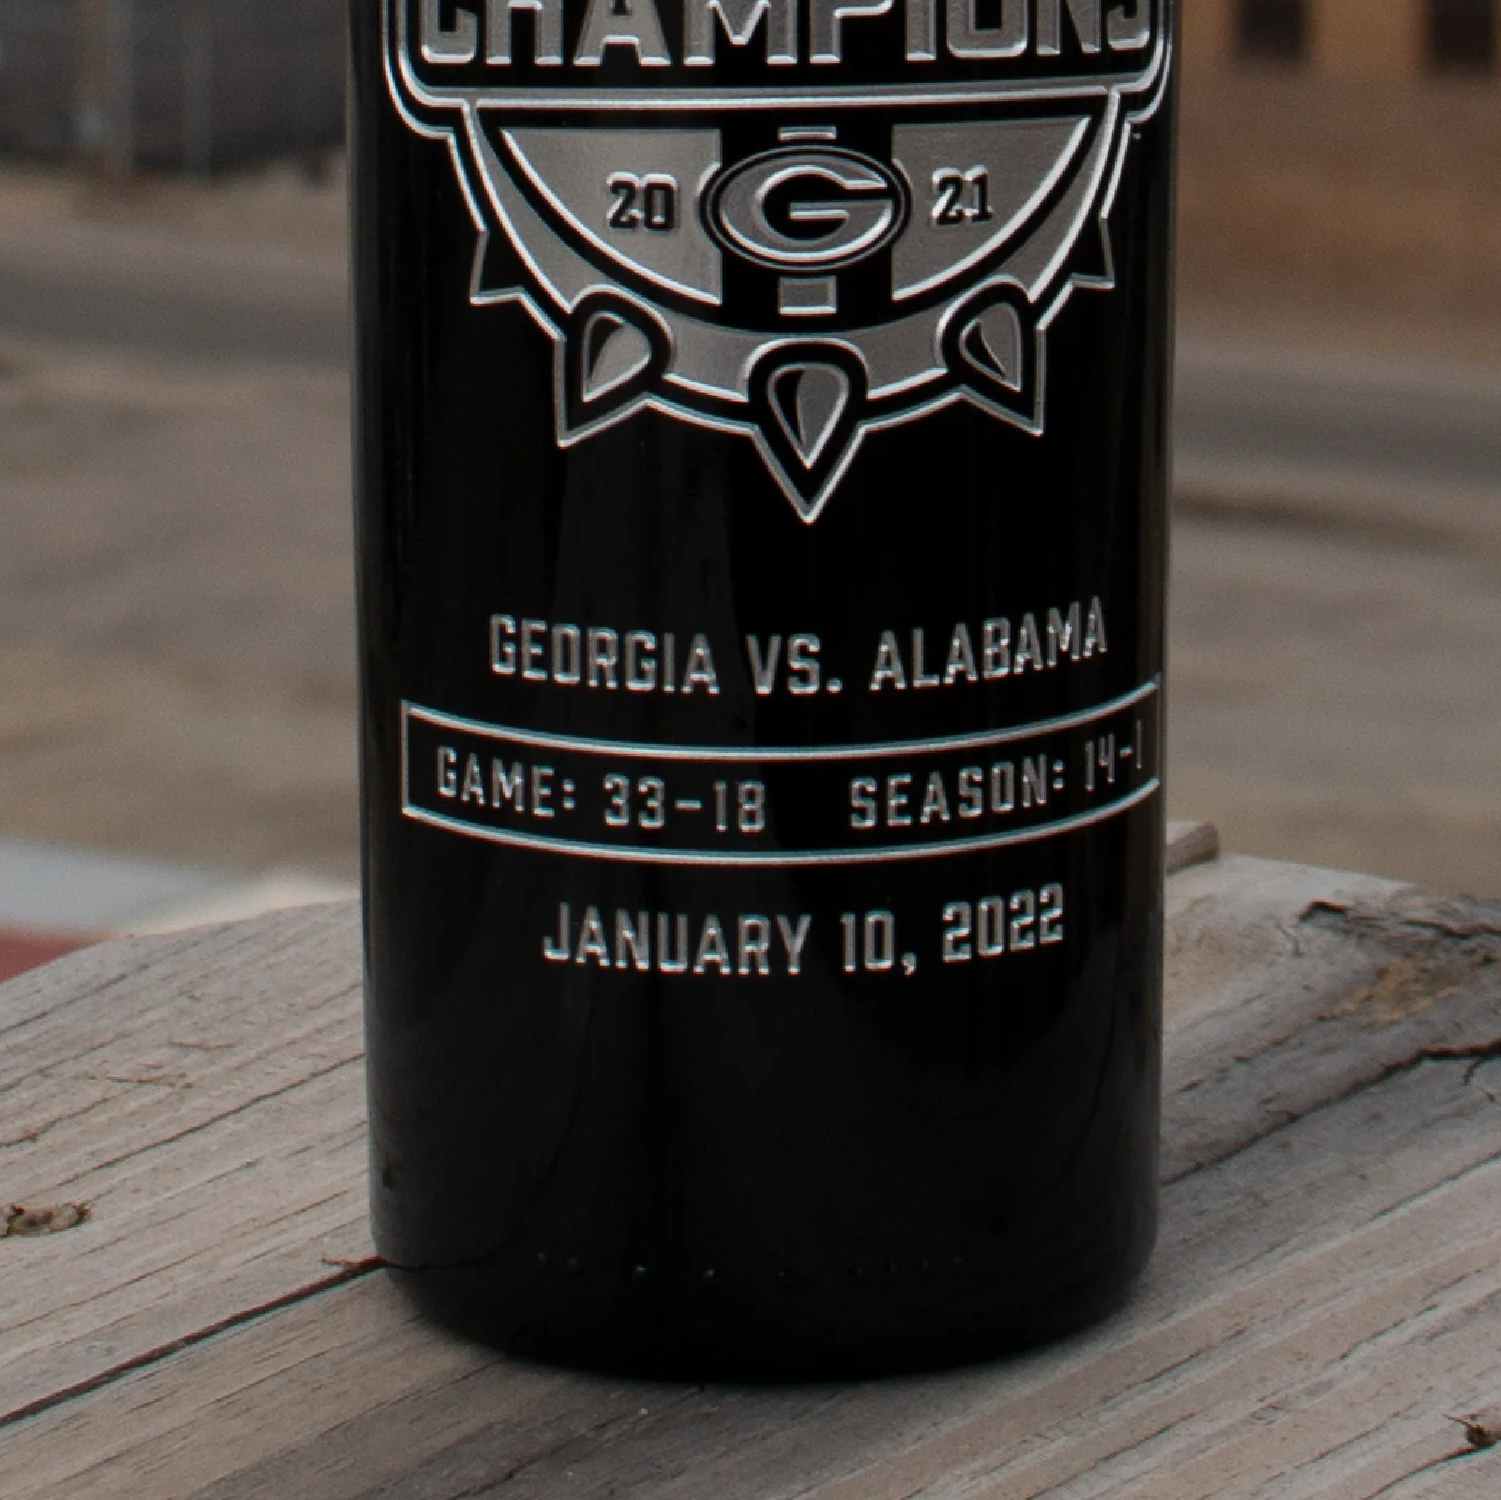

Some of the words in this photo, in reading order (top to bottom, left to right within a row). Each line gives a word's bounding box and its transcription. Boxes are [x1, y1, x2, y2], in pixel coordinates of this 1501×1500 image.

[607, 171, 679, 232] 20
[932, 166, 993, 237] 21
[489, 613, 719, 694] GEORGIA
[746, 633, 843, 694] VS.
[869, 595, 1108, 692] ALABAMA
[436, 745, 576, 818] GAME:
[603, 774, 766, 833] 33-18
[849, 752, 1066, 829] SEASON:
[543, 902, 811, 976] JANUARY
[840, 910, 918, 977] 10,
[941, 882, 1065, 963] 2022
